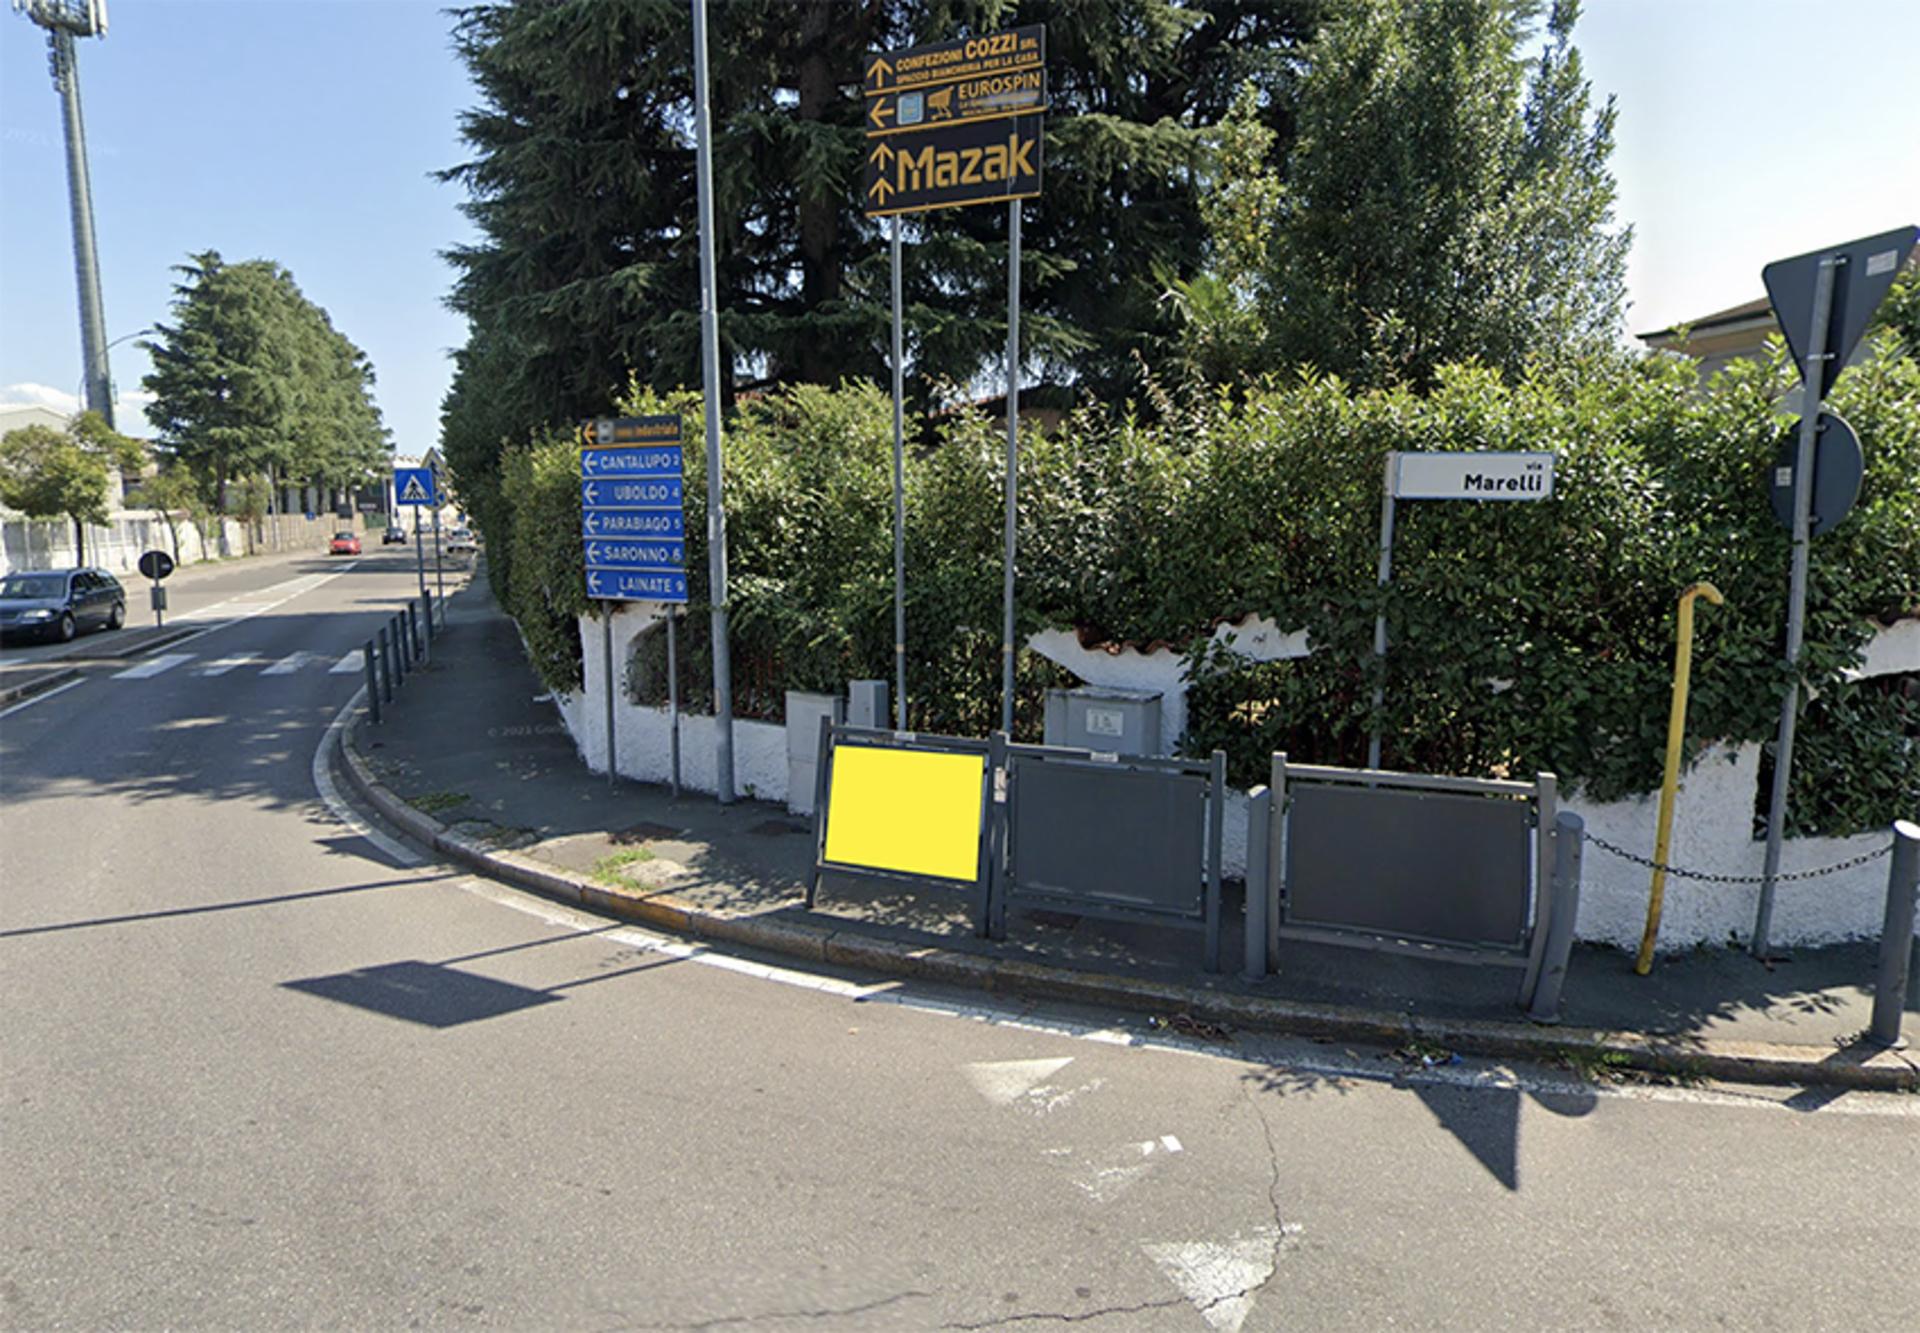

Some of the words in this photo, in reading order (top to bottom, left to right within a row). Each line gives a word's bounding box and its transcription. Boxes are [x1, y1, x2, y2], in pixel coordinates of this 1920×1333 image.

[896, 49, 963, 71] CONFEZIONI
[966, 33, 1018, 59] COZZI
[959, 73, 1040, 99] EUROSPIN
[898, 134, 1035, 192] Mazak
[600, 453, 672, 470] CANTALUPO
[1525, 461, 1543, 470] via
[1464, 474, 1542, 491] Marelli
[614, 485, 668, 500] UBOLDO
[602, 516, 671, 531] PARABIAGO
[604, 545, 669, 562] SARONNO
[619, 577, 672, 592] LAINATE
